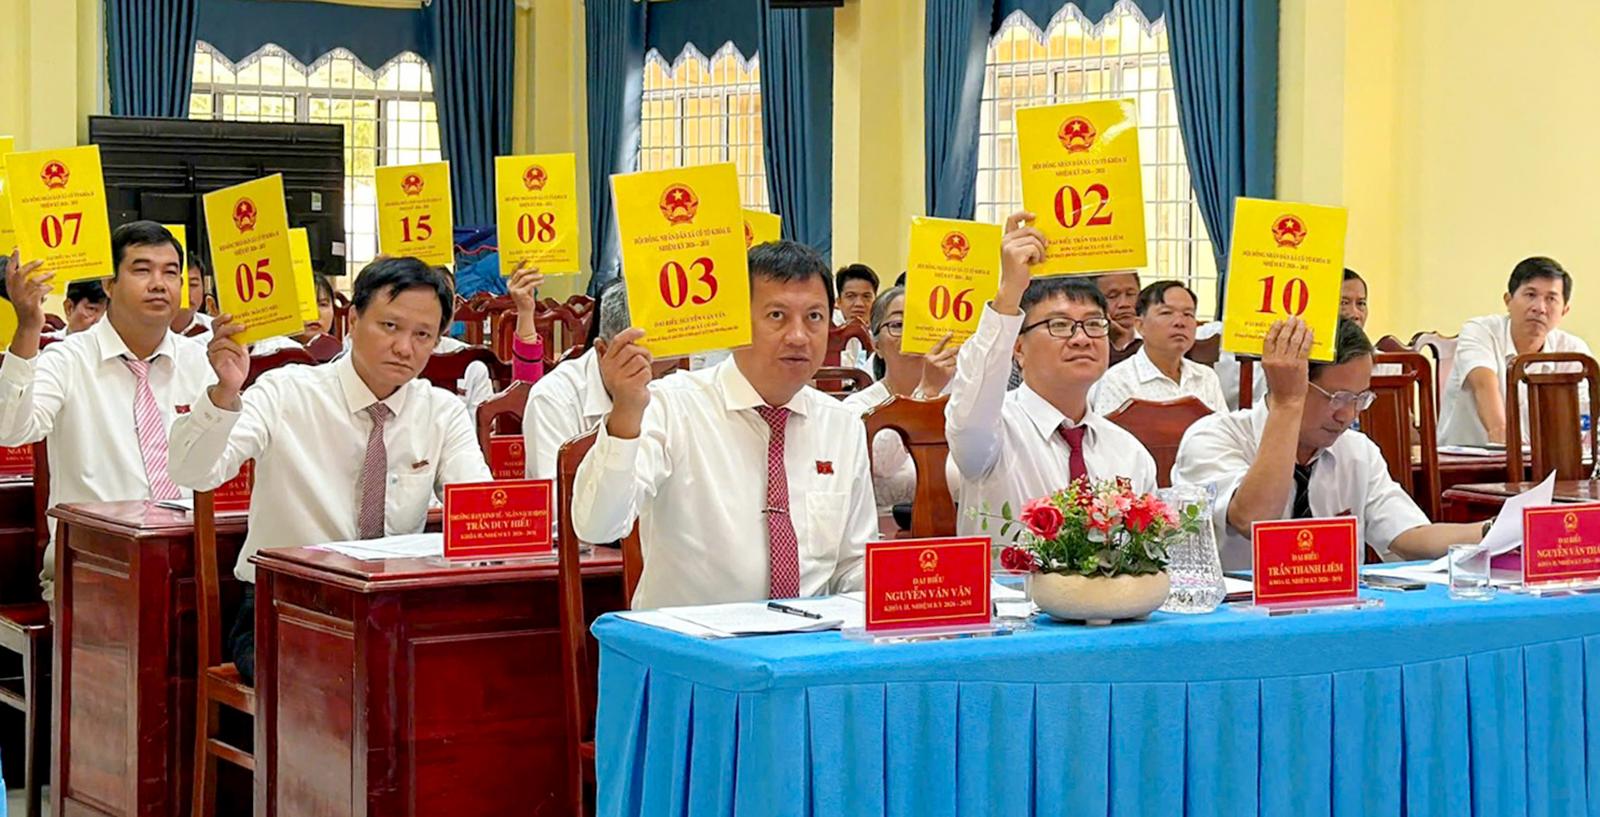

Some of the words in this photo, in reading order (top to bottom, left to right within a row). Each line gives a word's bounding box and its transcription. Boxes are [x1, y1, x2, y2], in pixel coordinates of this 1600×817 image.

[1054, 183, 1113, 228] 02
[41, 212, 82, 248] 07
[400, 214, 433, 242] 15
[517, 212, 556, 244] 08
[235, 258, 274, 303] 05
[659, 256, 718, 309] 03
[1255, 275, 1309, 316] 10
[929, 285, 975, 323] 06
[466, 518, 490, 531] TRẦN
[491, 521, 509, 529] DUY
[511, 517, 532, 528] HIẾU
[1537, 544, 1569, 558] NGUYỄN
[912, 577, 926, 586] ĐẠI
[927, 573, 945, 585] BIỂU
[1268, 562, 1291, 576] TRẦN
[1291, 564, 1321, 575] THANH
[1322, 561, 1344, 573] LIÊM
[885, 585, 927, 602] NGUYỄN
[928, 586, 949, 599] VĂN
